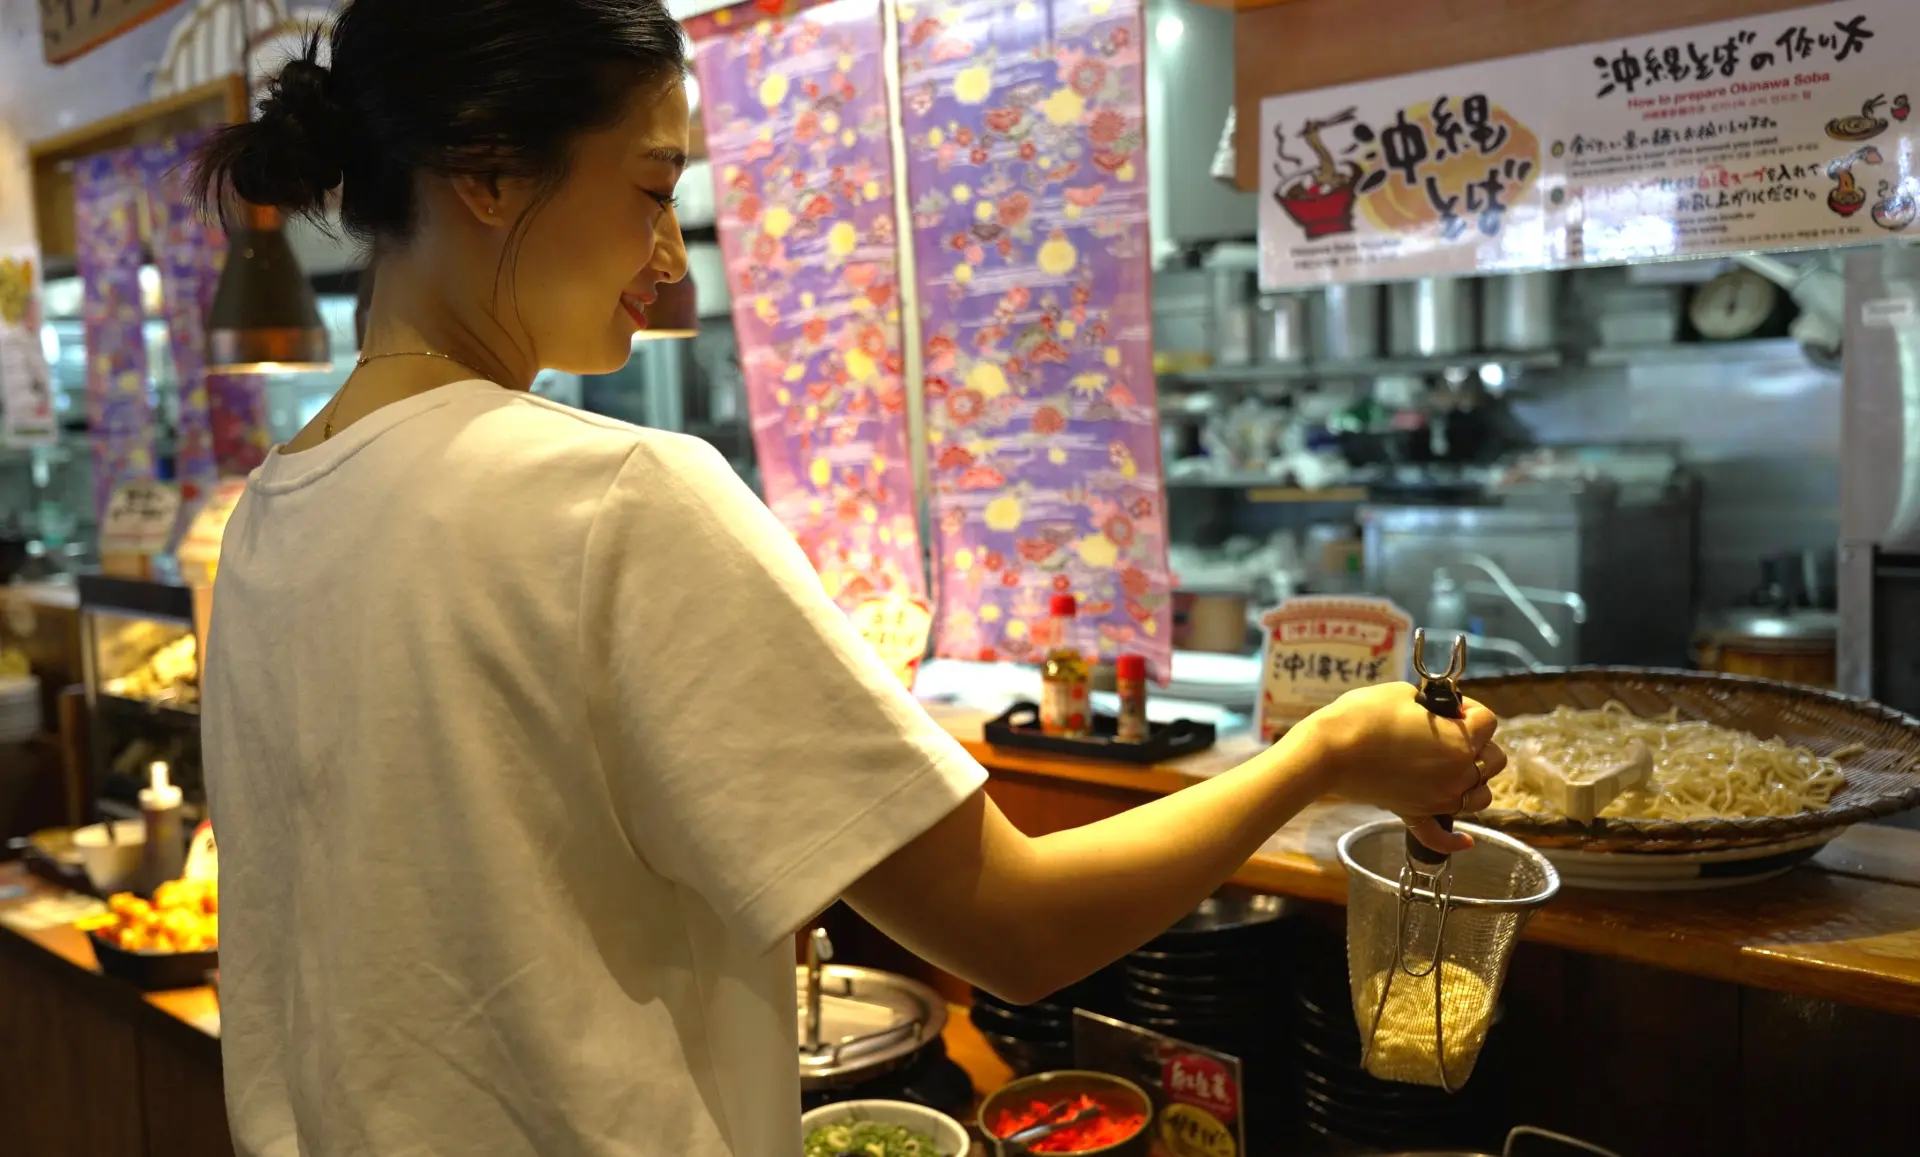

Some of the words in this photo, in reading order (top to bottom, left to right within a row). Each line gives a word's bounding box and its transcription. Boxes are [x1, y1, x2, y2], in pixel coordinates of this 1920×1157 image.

[1593, 15, 1874, 98] 沖縄そばの作り方
[1627, 96, 1656, 110] How
[1658, 94, 1672, 105] to
[1674, 86, 1727, 105] prepare
[1730, 77, 1790, 96] Okinawa
[1794, 71, 1831, 86] Soba
[1353, 94, 1507, 192] 沖縄
[1425, 158, 1532, 240] そば
